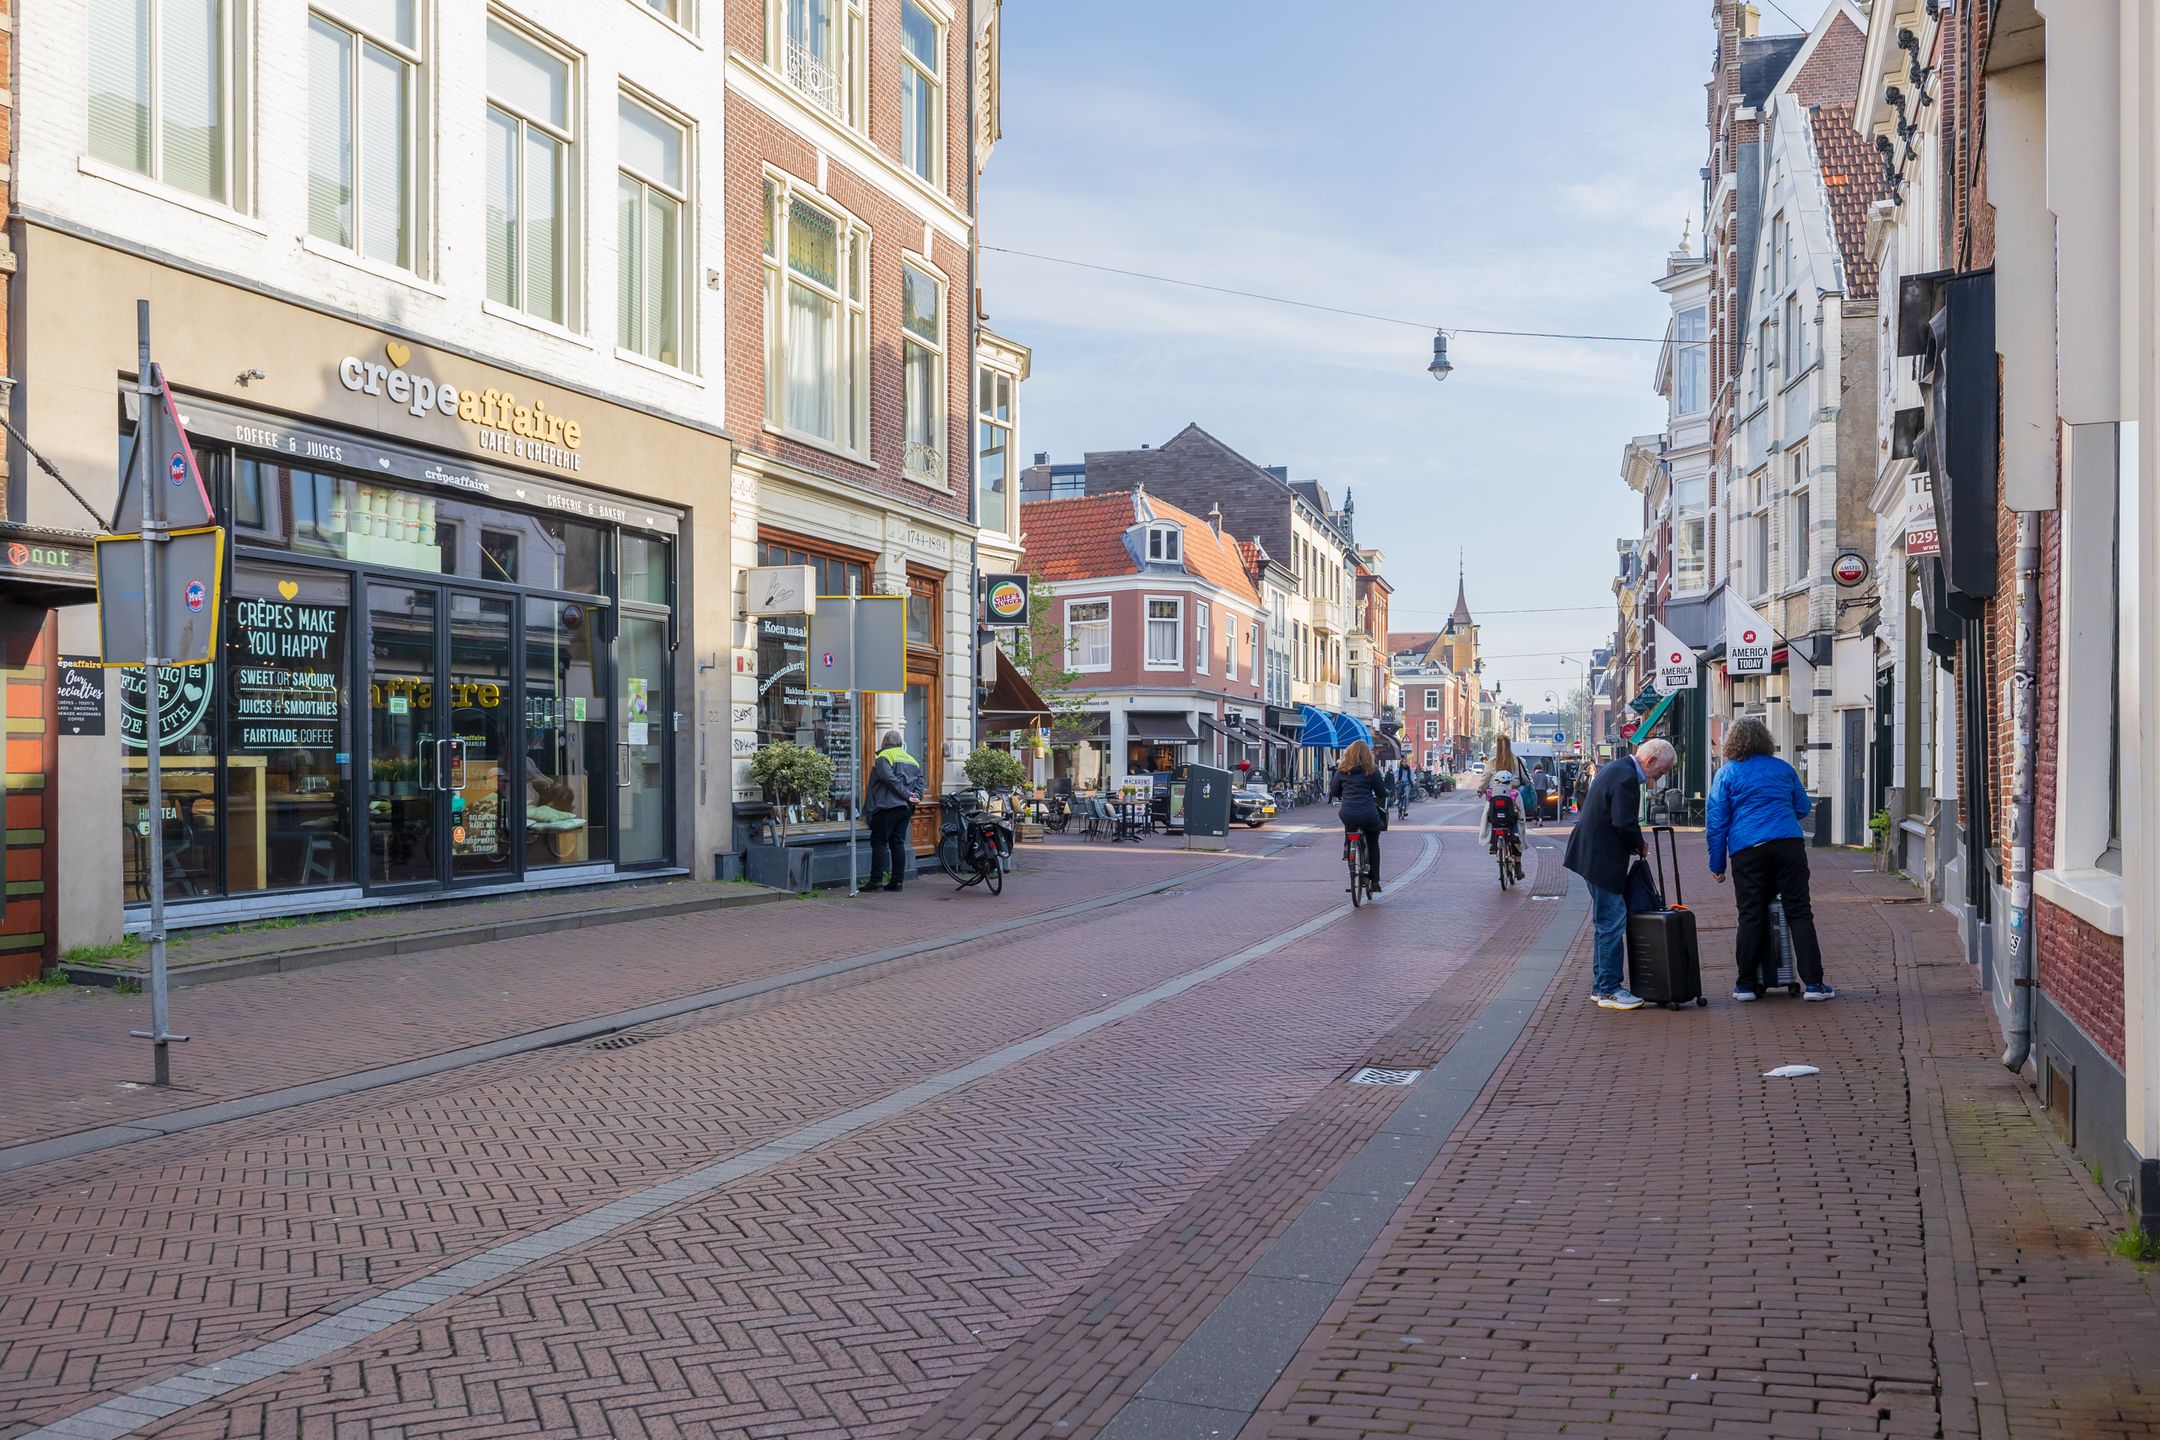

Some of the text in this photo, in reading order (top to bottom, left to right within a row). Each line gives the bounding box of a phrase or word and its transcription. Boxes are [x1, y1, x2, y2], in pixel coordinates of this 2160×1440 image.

[236, 425, 342, 461] COFFEE & JUICES
[479, 429, 511, 454] CAFÉ
[515, 439, 523, 457] &
[589, 503, 594, 515] &
[600, 506, 626, 521] BAKERY
[907, 530, 946, 552] 1744-1894
[994, 593, 1020, 603] CHEF'S
[994, 598, 1023, 609] BURGER
[237, 597, 336, 633] CRÊPES MAKE
[764, 620, 786, 635] Koen
[248, 631, 328, 660] YOU HAPPY
[1731, 647, 1769, 658] AMERICA
[1661, 667, 1692, 676] AMERICA
[1739, 659, 1762, 669] TODAY
[66, 669, 87, 685] Our
[241, 670, 335, 687] SWEET OR SAVOURY
[759, 660, 805, 695] Schoenmakerij
[1668, 676, 1687, 685] TODAY
[121, 674, 170, 700] FLOR
[238, 698, 338, 715] JUICES & SMOOTHIES
[243, 728, 334, 743] FAIRTRADE COFFEE
[1124, 778, 1151, 786] MACARONS
[161, 807, 177, 819] TEA
